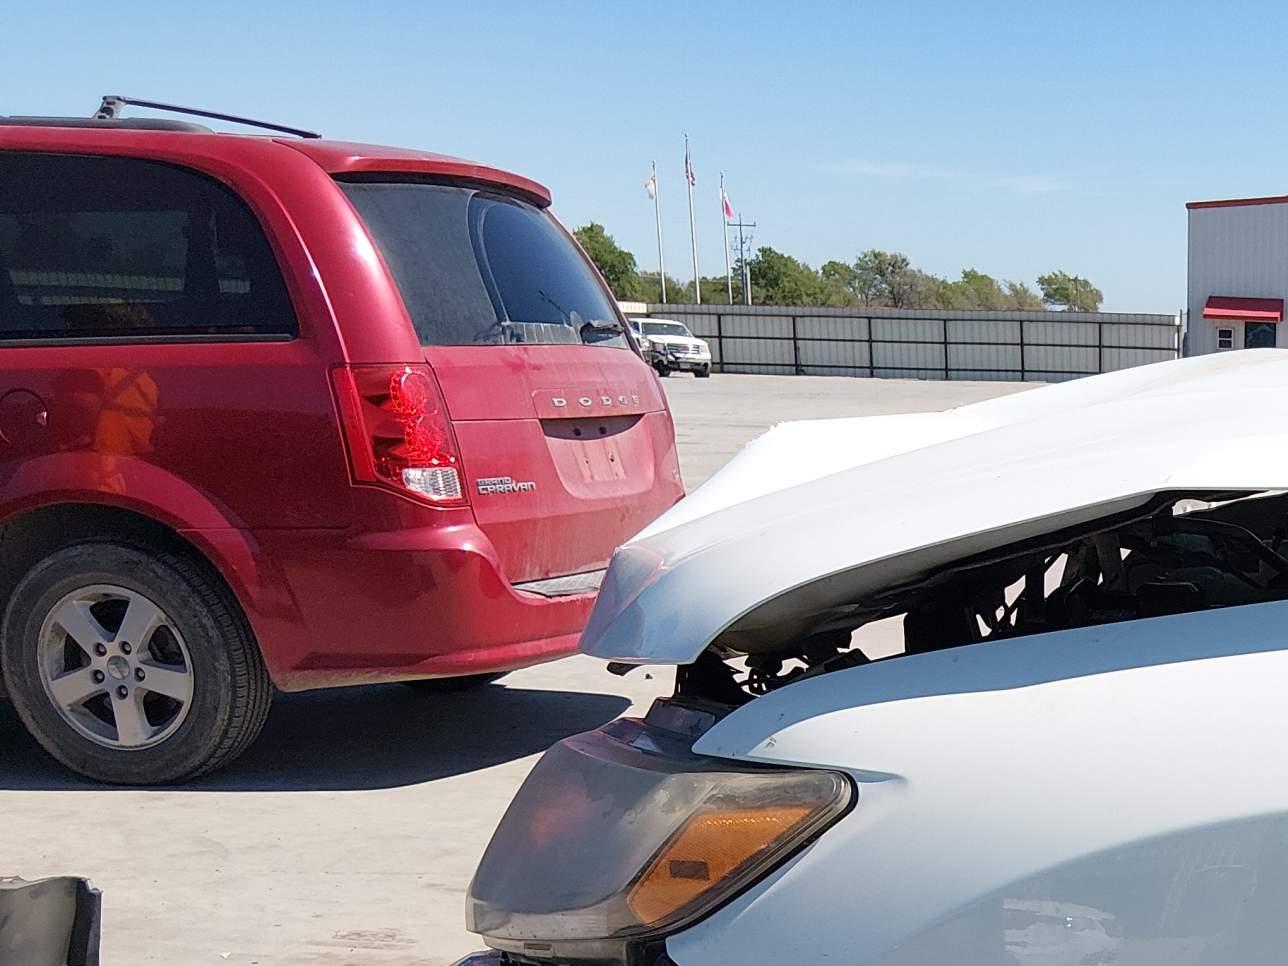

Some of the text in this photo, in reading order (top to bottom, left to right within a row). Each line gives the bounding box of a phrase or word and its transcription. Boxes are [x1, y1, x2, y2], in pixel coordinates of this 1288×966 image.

[551, 394, 640, 407] DODGE
[476, 476, 512, 485] GRAND
[477, 480, 536, 493] CARAVAN
